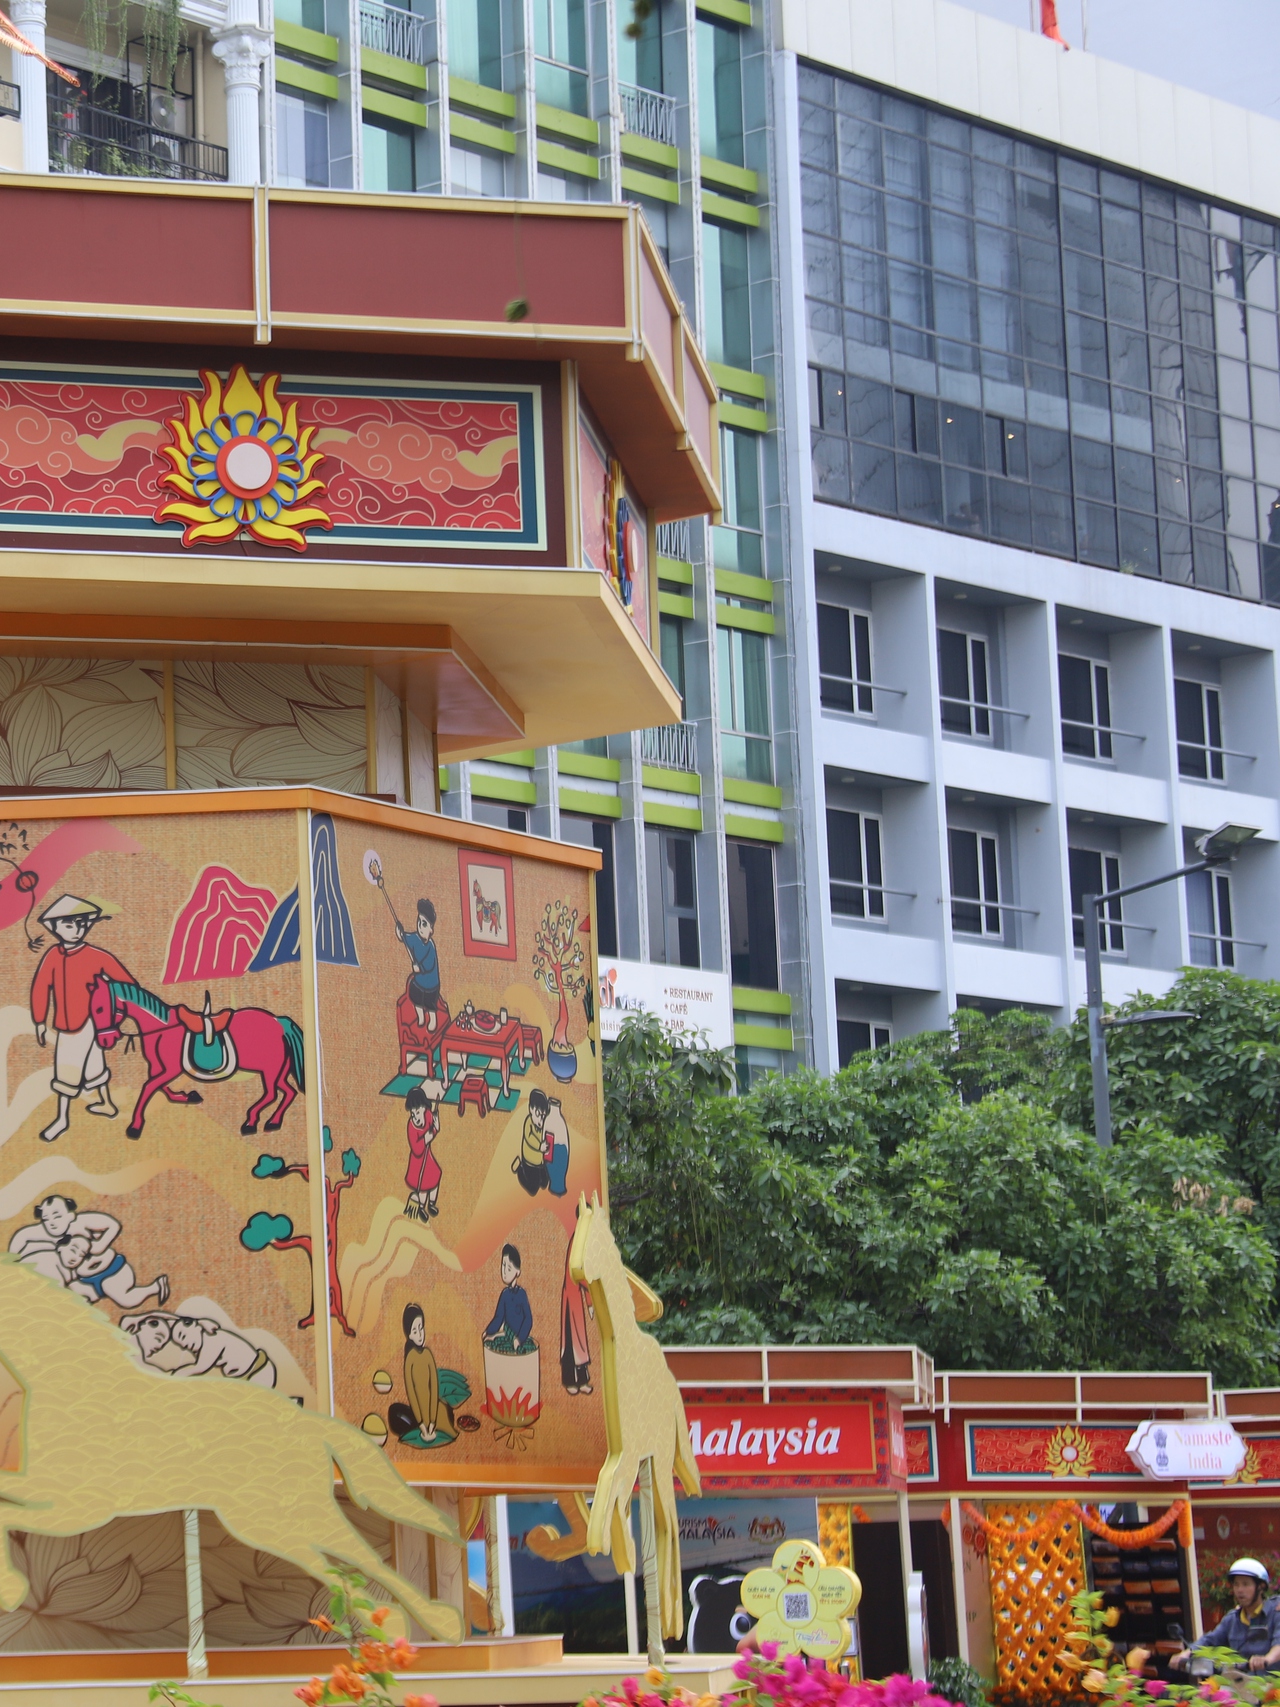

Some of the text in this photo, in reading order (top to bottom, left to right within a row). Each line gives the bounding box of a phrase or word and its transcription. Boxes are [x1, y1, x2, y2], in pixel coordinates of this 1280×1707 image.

[669, 987, 714, 1003] RESTAURANT
[669, 1002, 689, 1016] CAFÉ
[670, 1018, 685, 1031] BAR
[1175, 1428, 1232, 1447] Namaste
[1188, 1452, 1223, 1470] India
[678, 1517, 707, 1528] URISM
